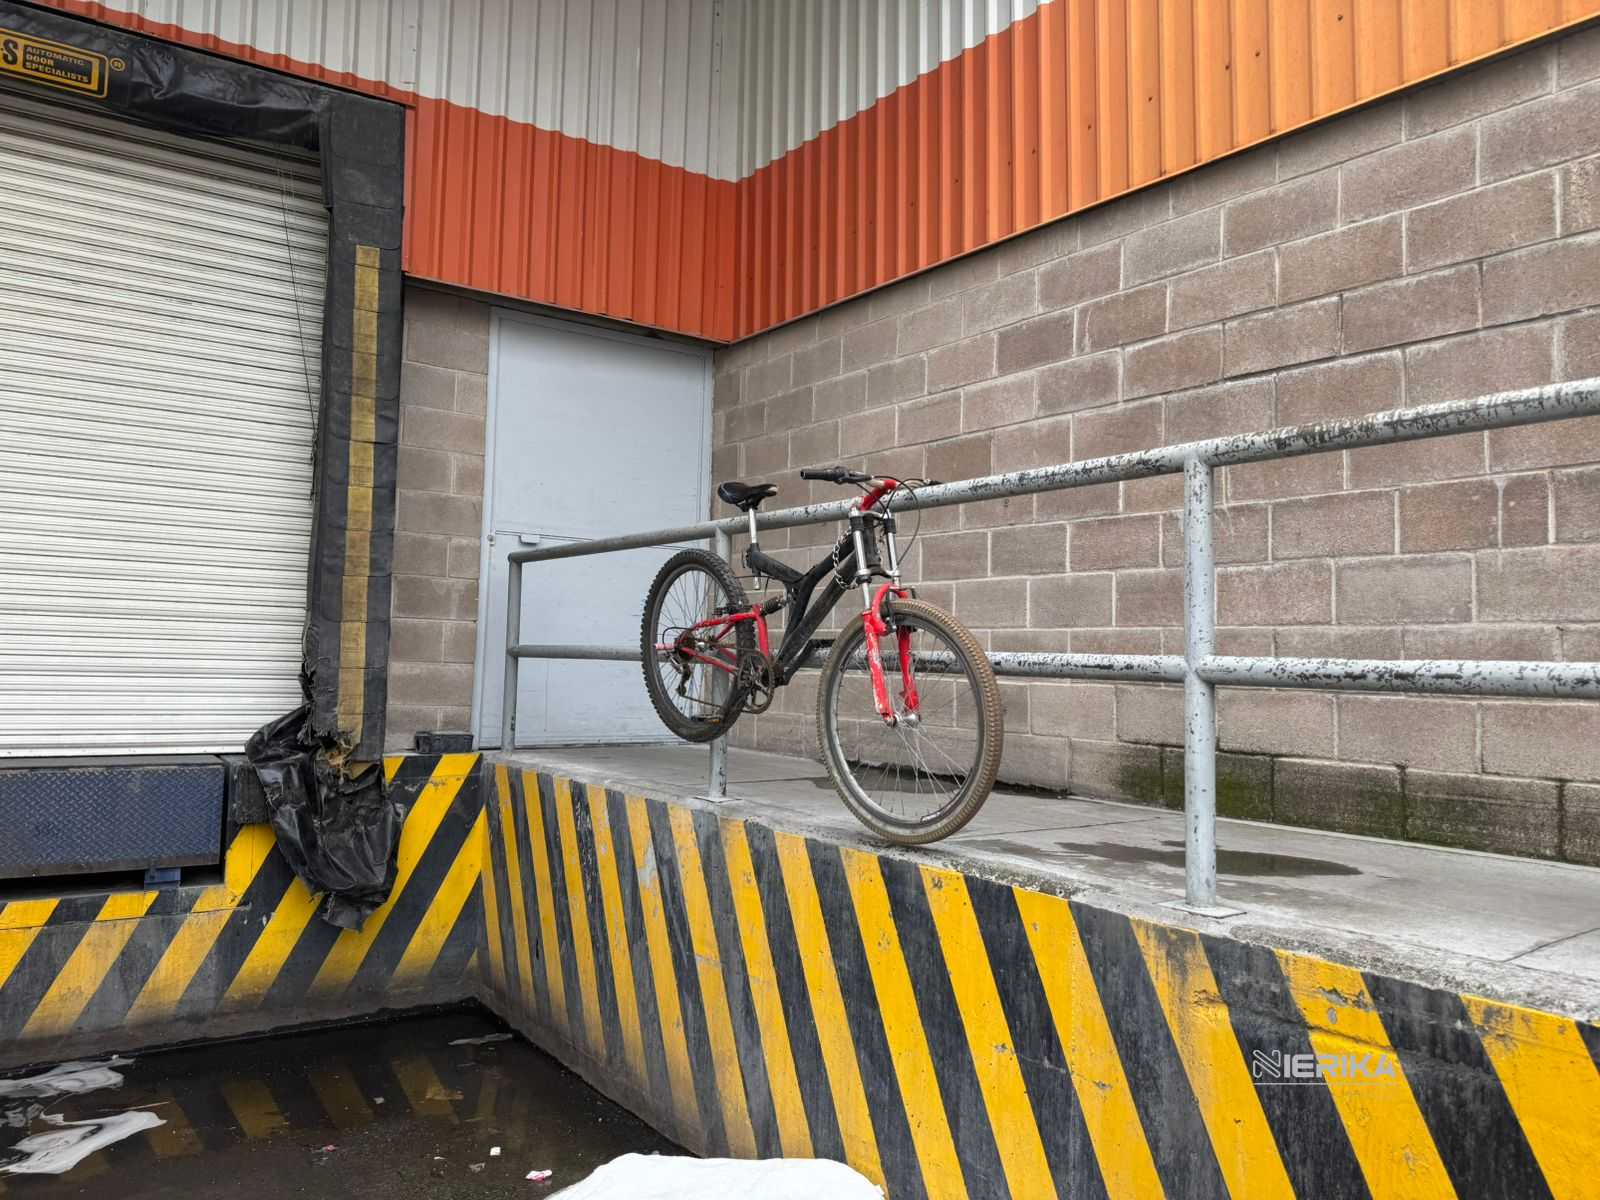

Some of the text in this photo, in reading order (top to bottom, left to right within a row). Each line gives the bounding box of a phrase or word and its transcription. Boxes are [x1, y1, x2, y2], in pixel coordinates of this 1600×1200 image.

[26, 46, 85, 66] AUTOMATIC
[26, 53, 54, 66] DOOR
[26, 62, 89, 82] SPECIALISTS
